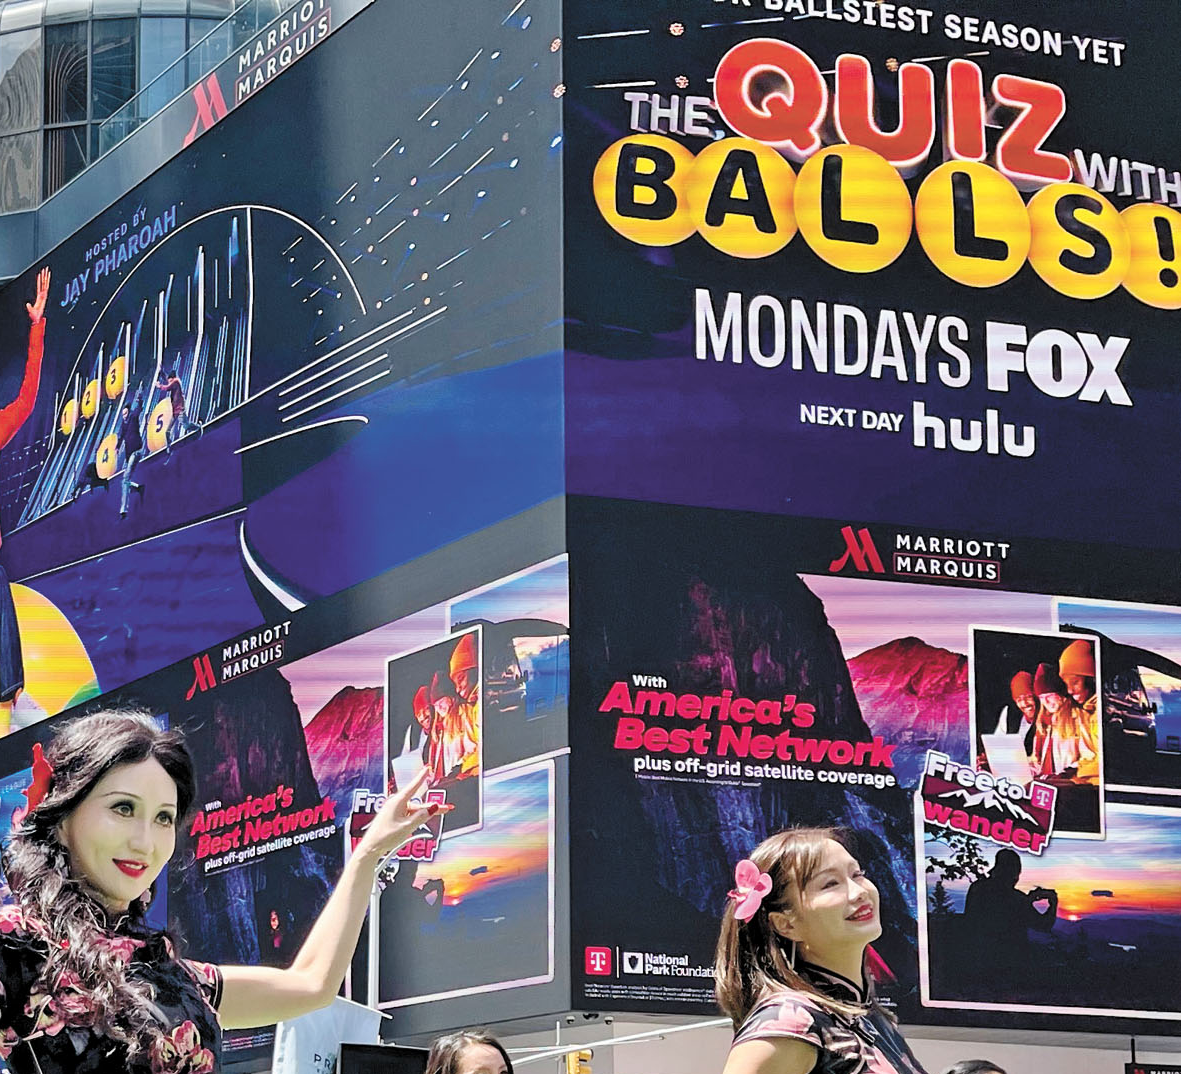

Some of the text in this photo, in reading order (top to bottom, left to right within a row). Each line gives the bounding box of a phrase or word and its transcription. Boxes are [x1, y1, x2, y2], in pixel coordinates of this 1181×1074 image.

[238, 16, 328, 101] MARQUIS
[945, 14, 1062, 56] SEASON
[1072, 34, 1125, 66] YET
[624, 37, 1181, 207] THE QUIZ WITH
[85, 207, 147, 262] HOSTED BY
[615, 140, 1180, 290] BALLS!
[60, 205, 176, 307] JAY PHAROAH
[695, 288, 1134, 406] MONDAYS FOX
[800, 401, 1036, 459] NEXT DAY hulu
[896, 534, 1011, 559] MARRIOTT
[897, 556, 997, 580] MARQUIS
[222, 621, 291, 661] MARRIOTT
[222, 644, 282, 679] MARQUIS
[598, 681, 817, 728] America's
[632, 674, 667, 688] With
[613, 717, 898, 768] Best Network
[633, 755, 671, 773] plus
[674, 757, 741, 778] off-grid
[744, 763, 816, 781] satellite
[817, 770, 896, 790] coverage
[926, 753, 995, 792] Free
[997, 777, 1025, 800] to
[190, 784, 293, 836] America's
[195, 796, 336, 859] Best Network
[205, 800, 221, 811] With
[923, 800, 1047, 852] wander
[205, 857, 222, 873] plus
[223, 847, 255, 864] off-grid
[256, 838, 292, 856] satellite
[293, 824, 336, 845] coverage
[645, 952, 689, 966] National
[645, 964, 717, 978] Park Foundati
